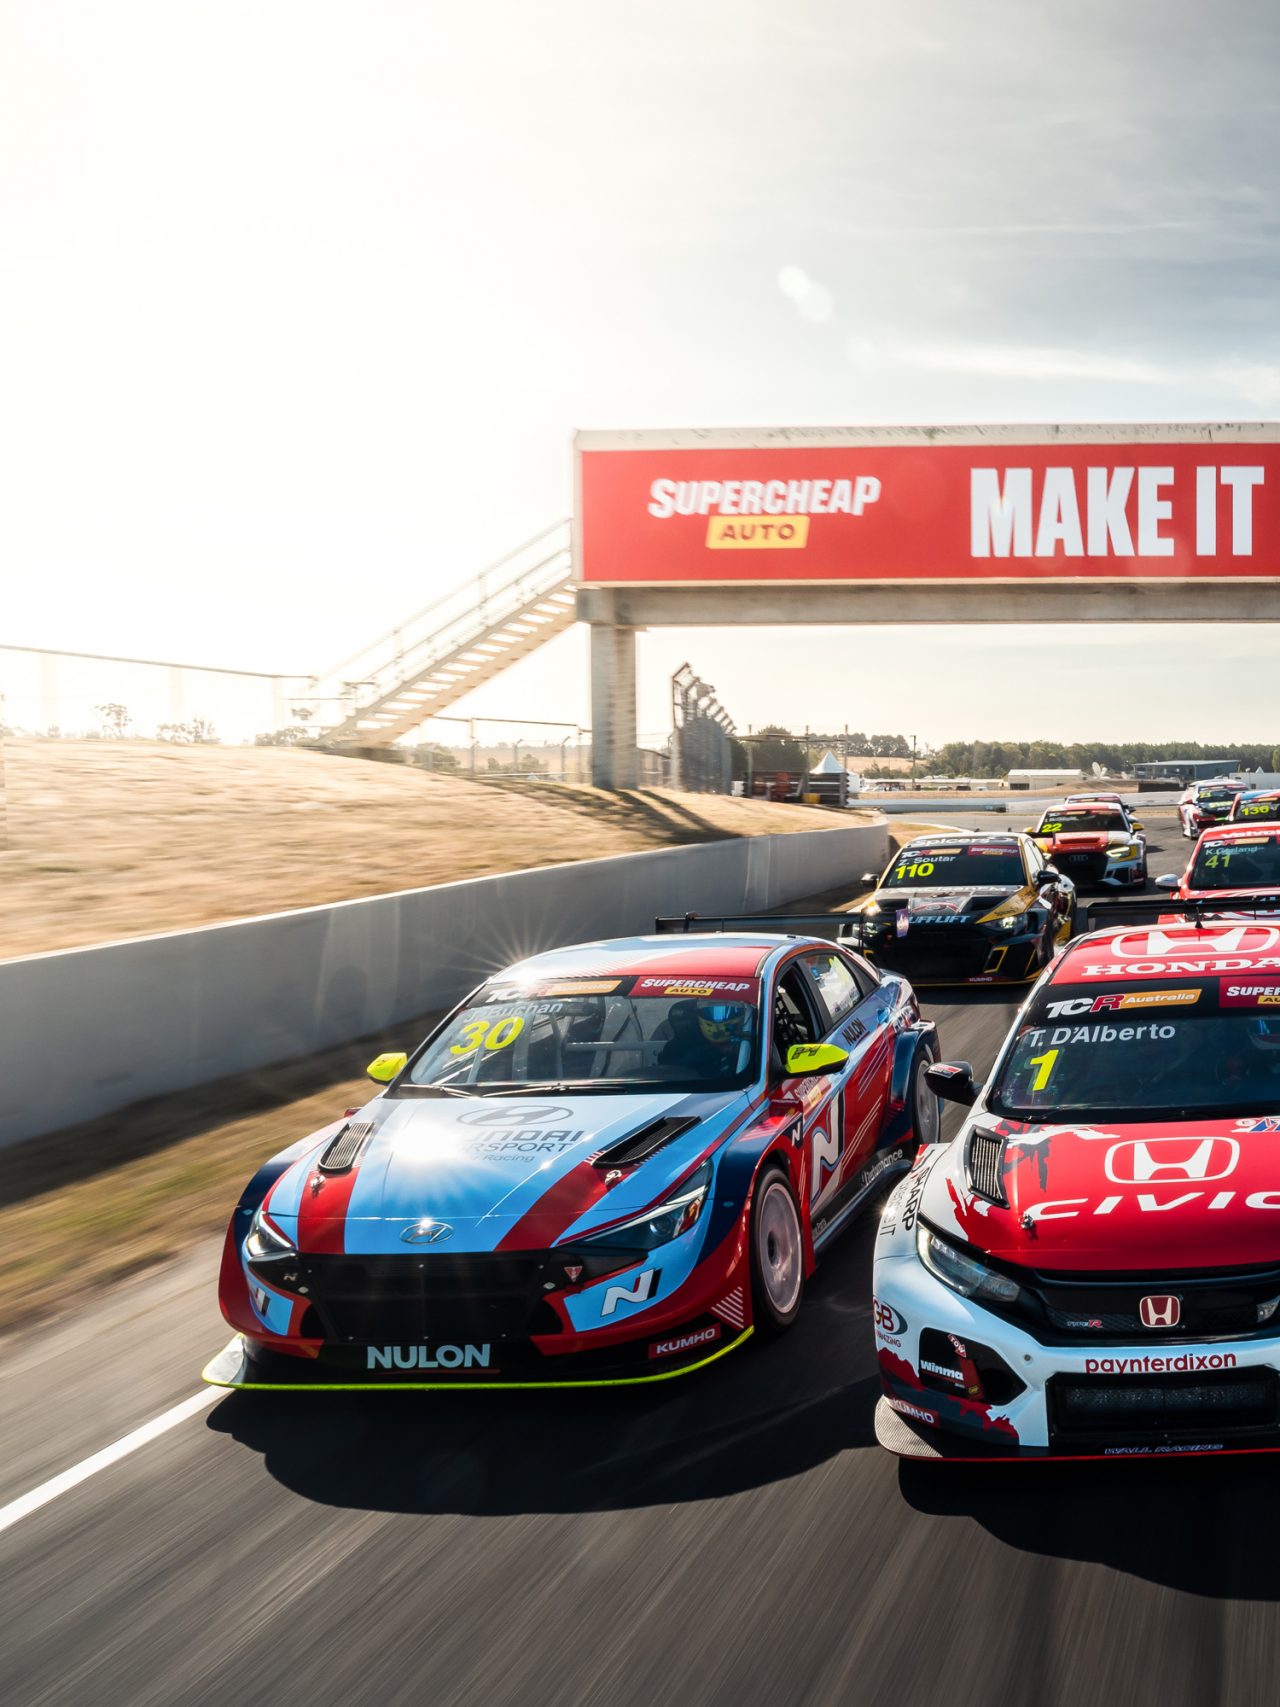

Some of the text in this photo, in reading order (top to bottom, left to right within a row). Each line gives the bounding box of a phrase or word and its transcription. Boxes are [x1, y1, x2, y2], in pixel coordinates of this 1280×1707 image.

[648, 476, 880, 517] SUPERCHEAP
[970, 467, 1175, 557] MAKE
[1196, 466, 1265, 556] IT
[720, 523, 795, 541] AUTO
[1041, 823, 1062, 833] 22
[896, 863, 934, 879] 110
[1205, 855, 1231, 868] 41
[909, 915, 971, 924] UFFLIFT
[641, 978, 750, 992] SUPERCHEAP
[1046, 993, 1195, 1019] TCR Australia
[450, 1016, 526, 1055] 30
[1029, 1028, 1044, 1048] T.
[1029, 1049, 1059, 1091] 1
[656, 1328, 716, 1354] KUMHO
[367, 1343, 491, 1369] NULON
[1085, 1353, 1237, 1375] paynterdixon
[920, 1360, 964, 1381] Winma
